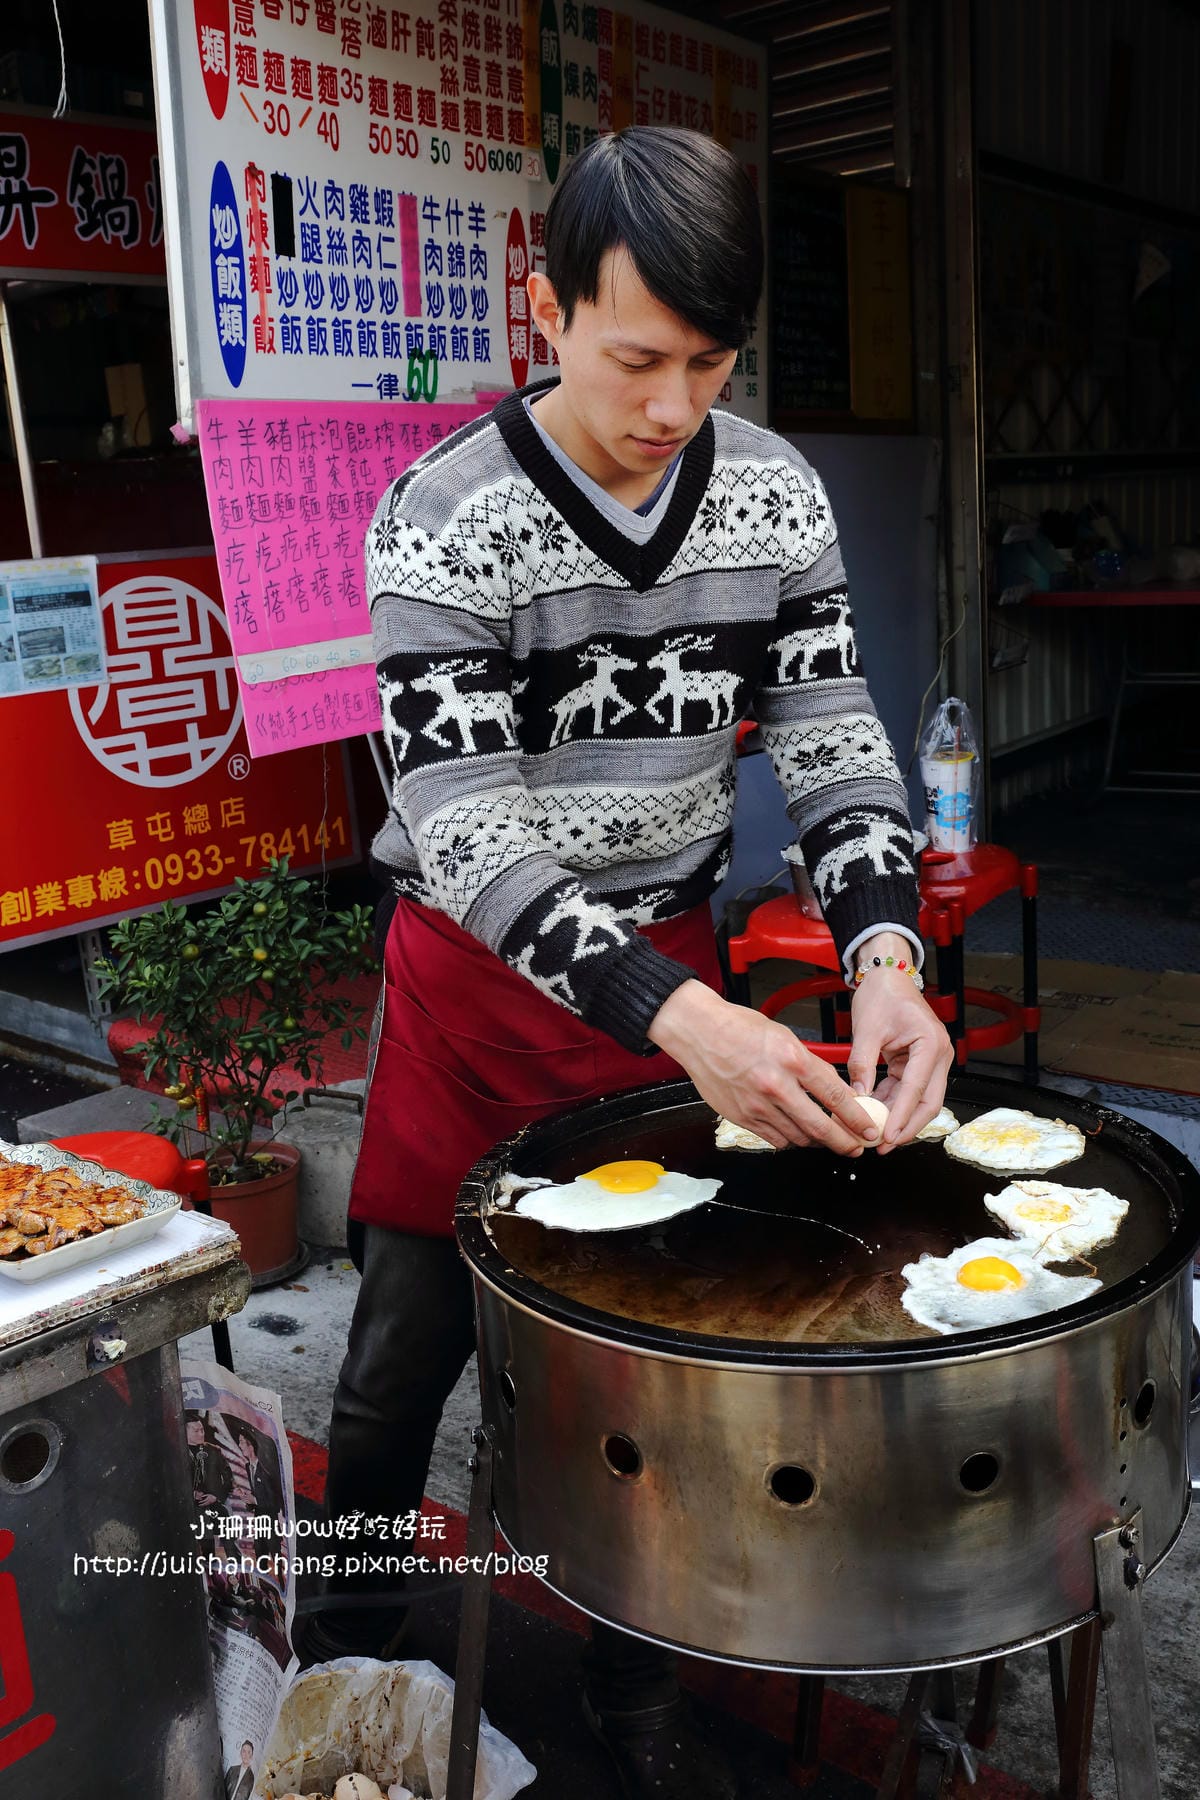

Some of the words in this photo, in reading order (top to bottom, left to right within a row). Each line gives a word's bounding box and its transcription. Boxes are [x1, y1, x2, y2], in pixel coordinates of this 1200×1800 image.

[202, 27, 229, 77] 類
[341, 68, 363, 104] 35
[391, 10, 414, 123] 肝麵
[461, 0, 483, 138] 燒意麵
[263, 100, 291, 137] 30
[317, 111, 340, 152] 40
[368, 122, 393, 155] 50
[396, 127, 420, 159] 50
[430, 136, 451, 165] 50
[464, 141, 487, 173] 50
[211, 203, 246, 347] 炒飯類
[297, 175, 330, 357] 火腿炒飯
[324, 179, 354, 358] 肉絲炒飯
[349, 183, 379, 359] 雞肉炒飯
[374, 186, 403, 360] 蝦仁炒飯
[422, 194, 448, 362] 牛肉炒飯
[445, 197, 471, 363] 什錦炒飯
[468, 201, 491, 364] 羊肉炒飯
[507, 243, 529, 361] 炒麵類
[351, 372, 400, 400] 一律
[106, 797, 247, 852] 草屯總店
